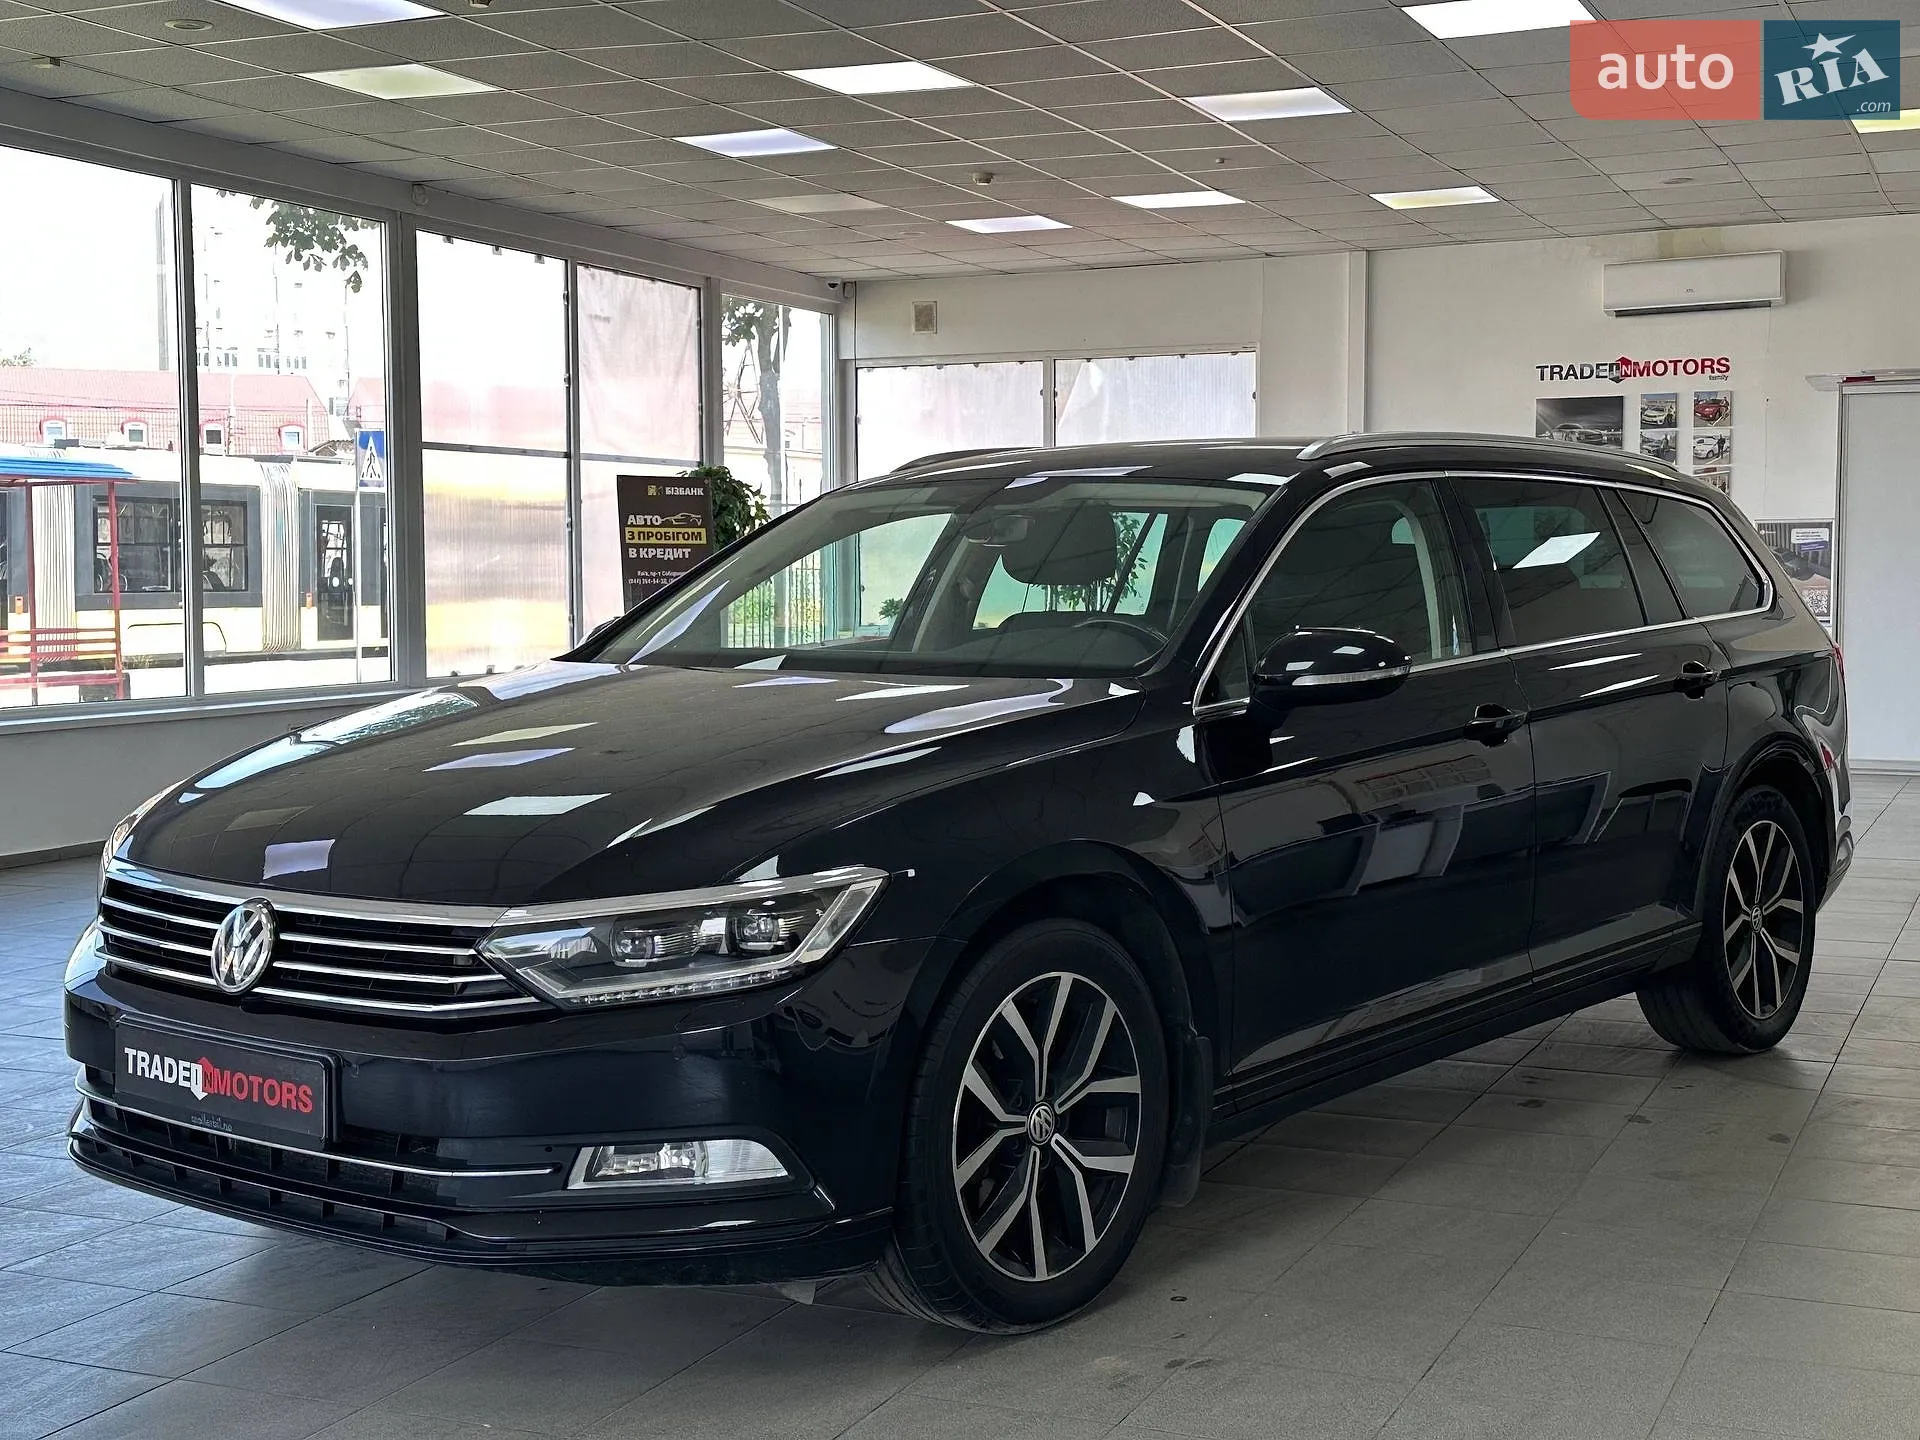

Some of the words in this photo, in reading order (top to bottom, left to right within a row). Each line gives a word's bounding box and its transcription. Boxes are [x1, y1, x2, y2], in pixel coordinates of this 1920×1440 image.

[665, 486, 704, 496] БІЗБАНК
[627, 514, 661, 526] АВТО
[627, 530, 635, 541] З
[637, 531, 702, 542] ПРОБІГОМ
[628, 547, 637, 559] В
[639, 547, 691, 561] КРЕДИТ
